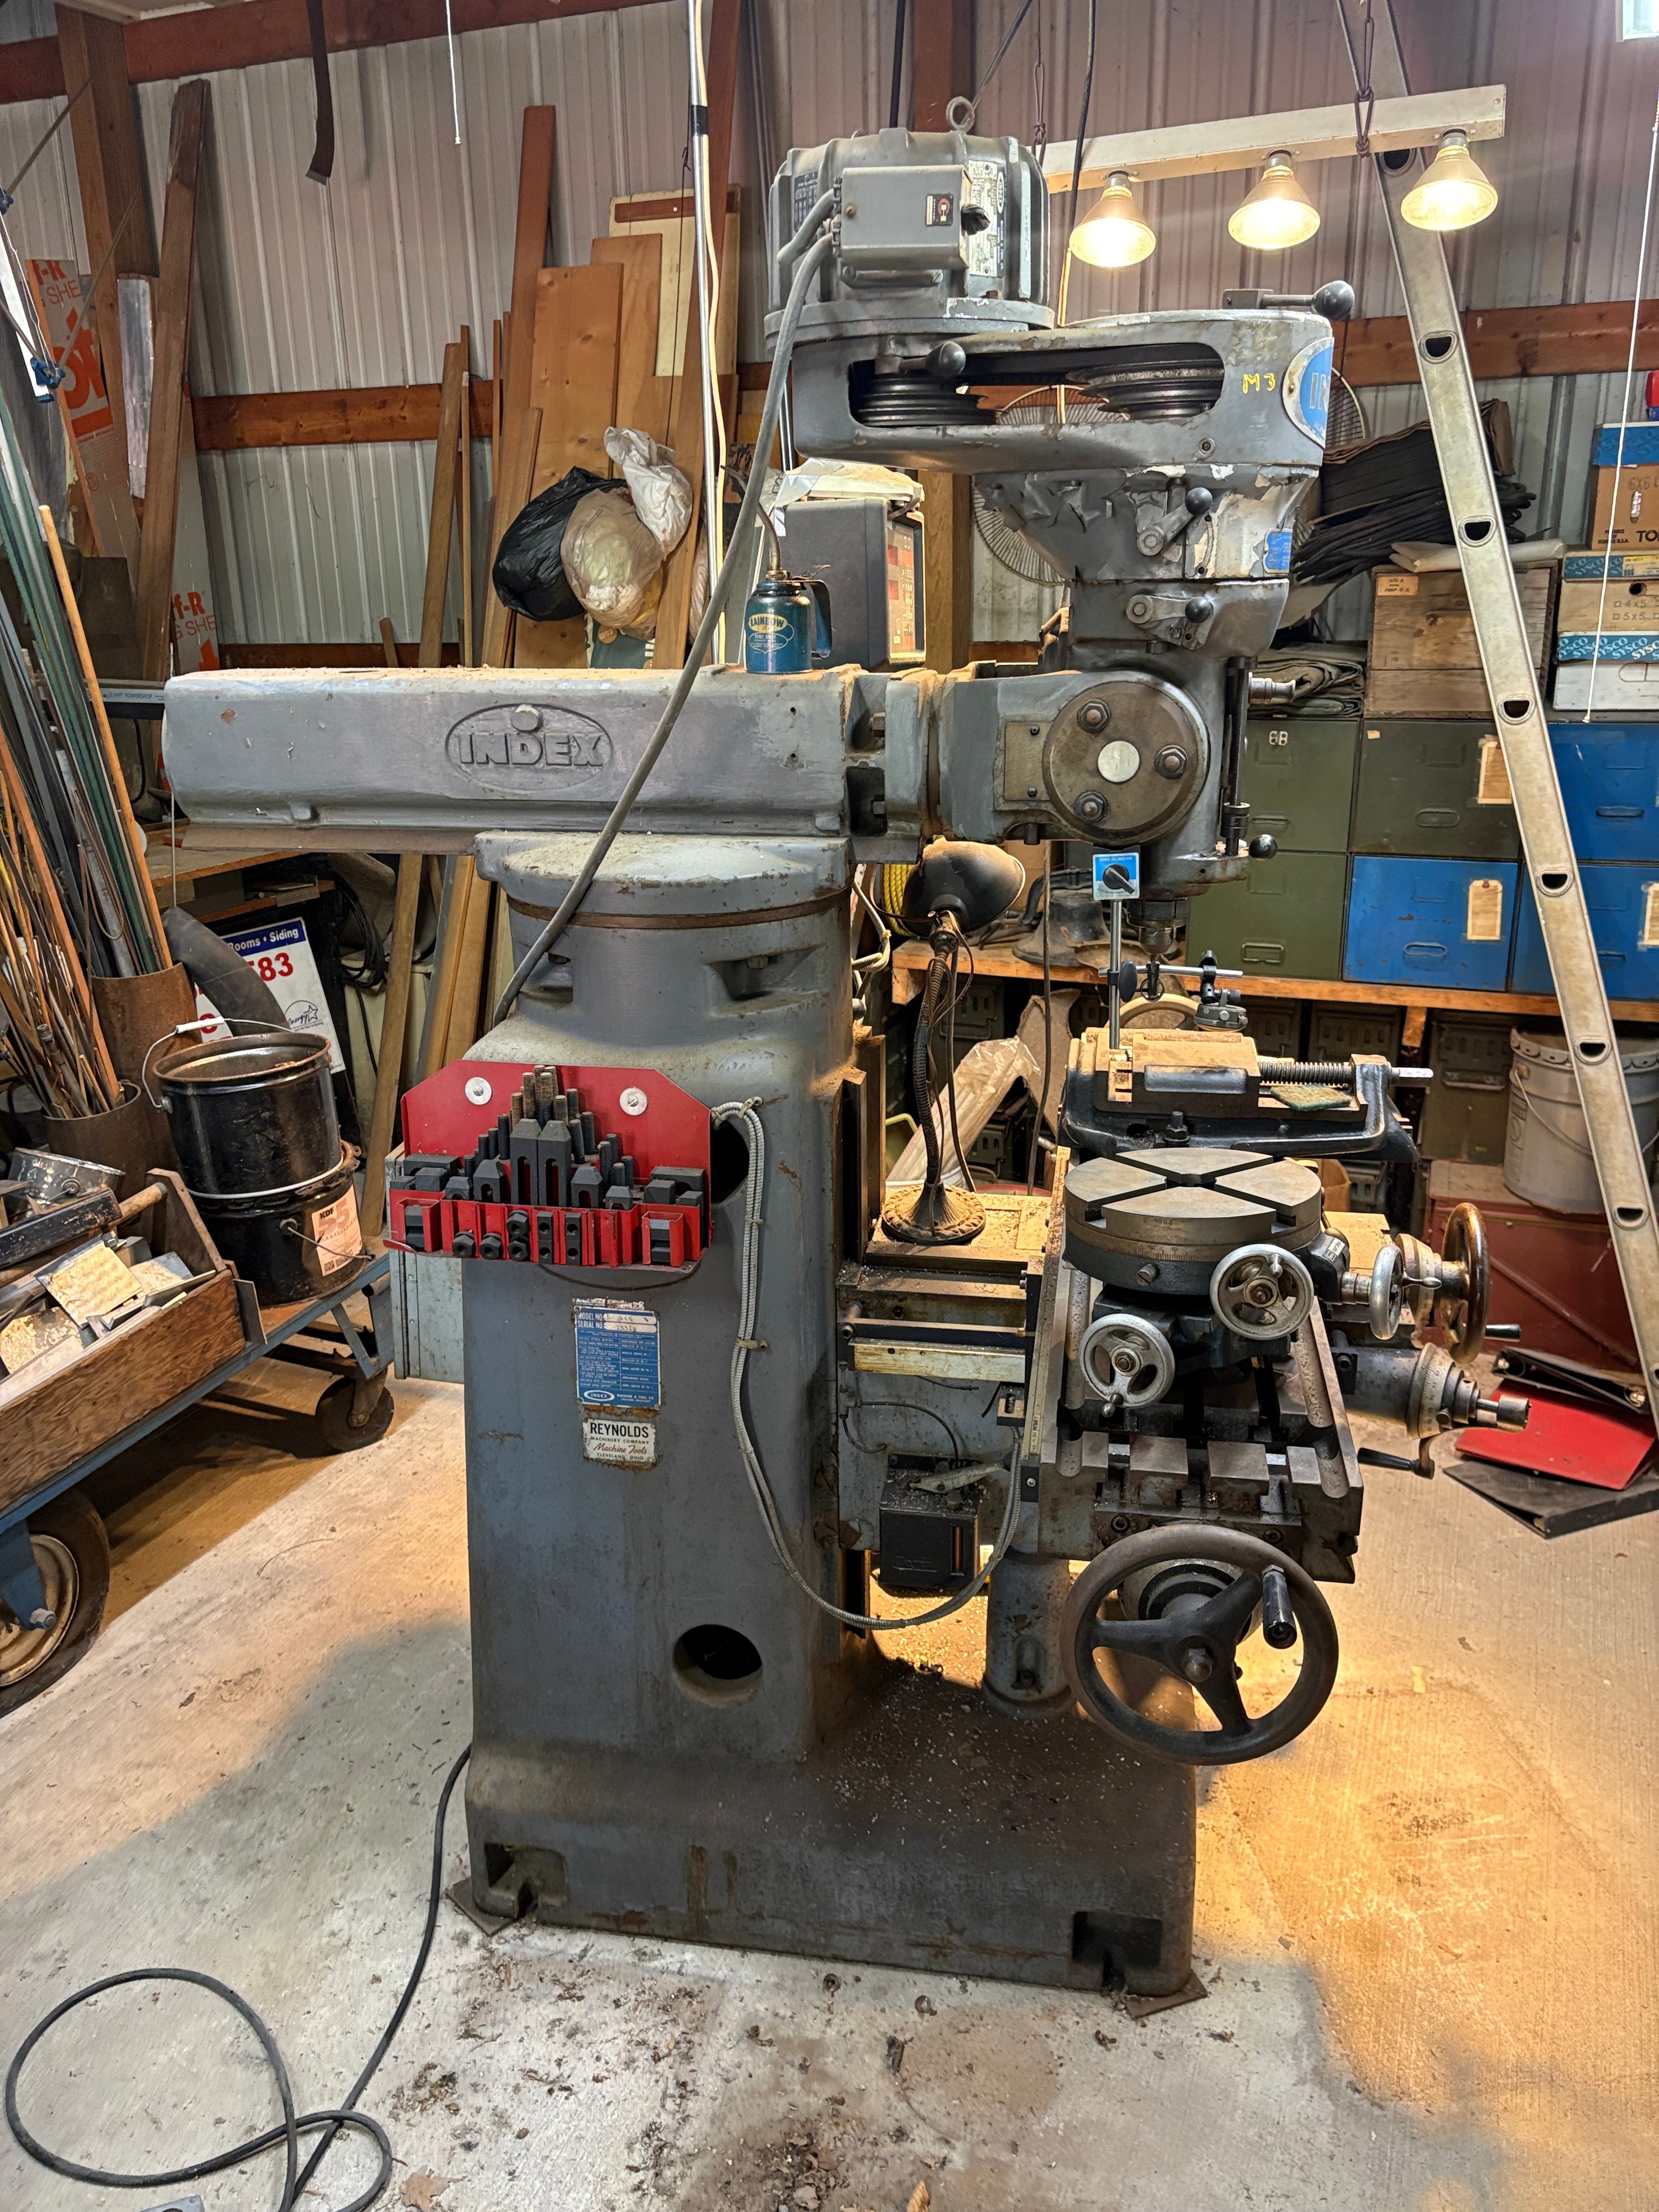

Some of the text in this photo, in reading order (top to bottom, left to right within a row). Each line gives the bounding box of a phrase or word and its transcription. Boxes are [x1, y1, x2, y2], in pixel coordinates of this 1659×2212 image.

[1636, 529, 1659, 542] TO
[185, 615, 216, 637] SHE
[1612, 637, 1648, 659] SYSCO
[458, 732, 604, 767] INDEX
[269, 927, 299, 942] Siding
[247, 952, 293, 982] 83
[320, 1207, 335, 1219] KDF
[590, 1422, 649, 1438] REYNOLDS
[593, 1442, 647, 1454] Machine Tools
